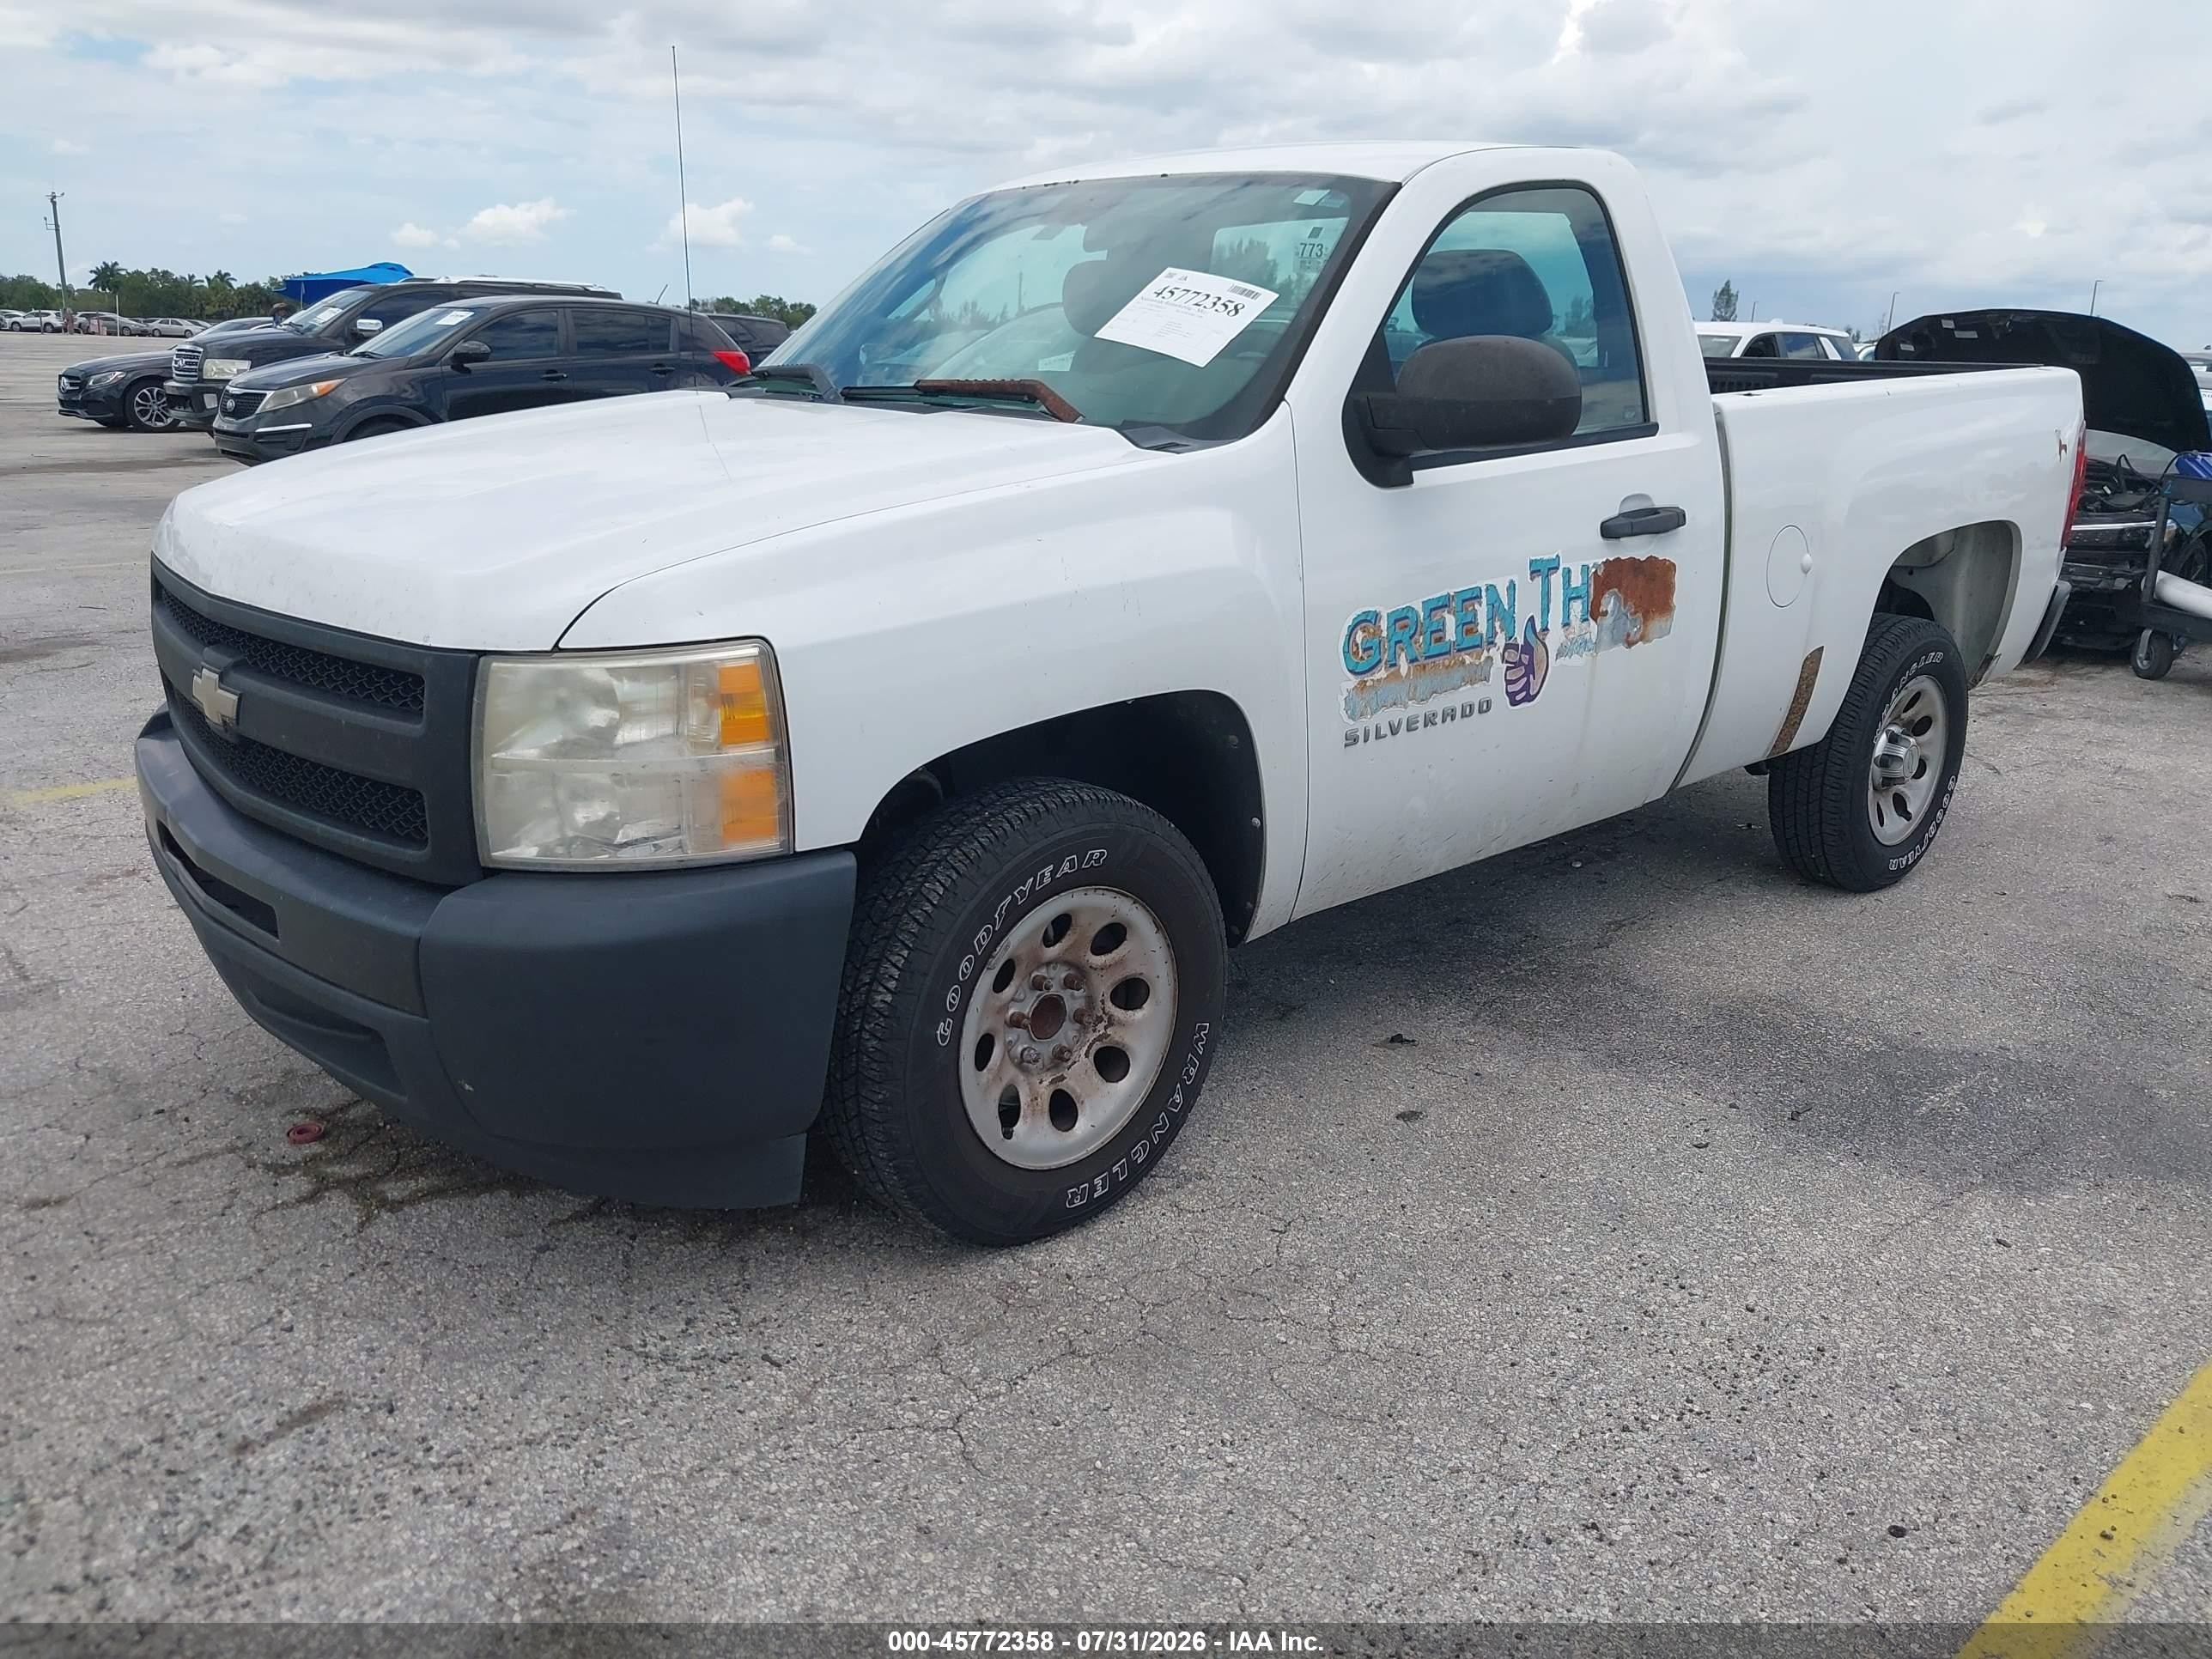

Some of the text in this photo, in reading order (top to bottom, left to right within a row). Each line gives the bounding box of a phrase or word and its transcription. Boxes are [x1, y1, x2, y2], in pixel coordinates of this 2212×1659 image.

[1299, 242, 1324, 258] 773
[1153, 284, 1246, 318] 45772358
[1343, 578, 1516, 677] GREEN
[1344, 696, 1492, 748] SILVERADO
[936, 848, 1109, 1047] GOODYEAR
[1064, 1020, 1211, 1210] WRANGLER
